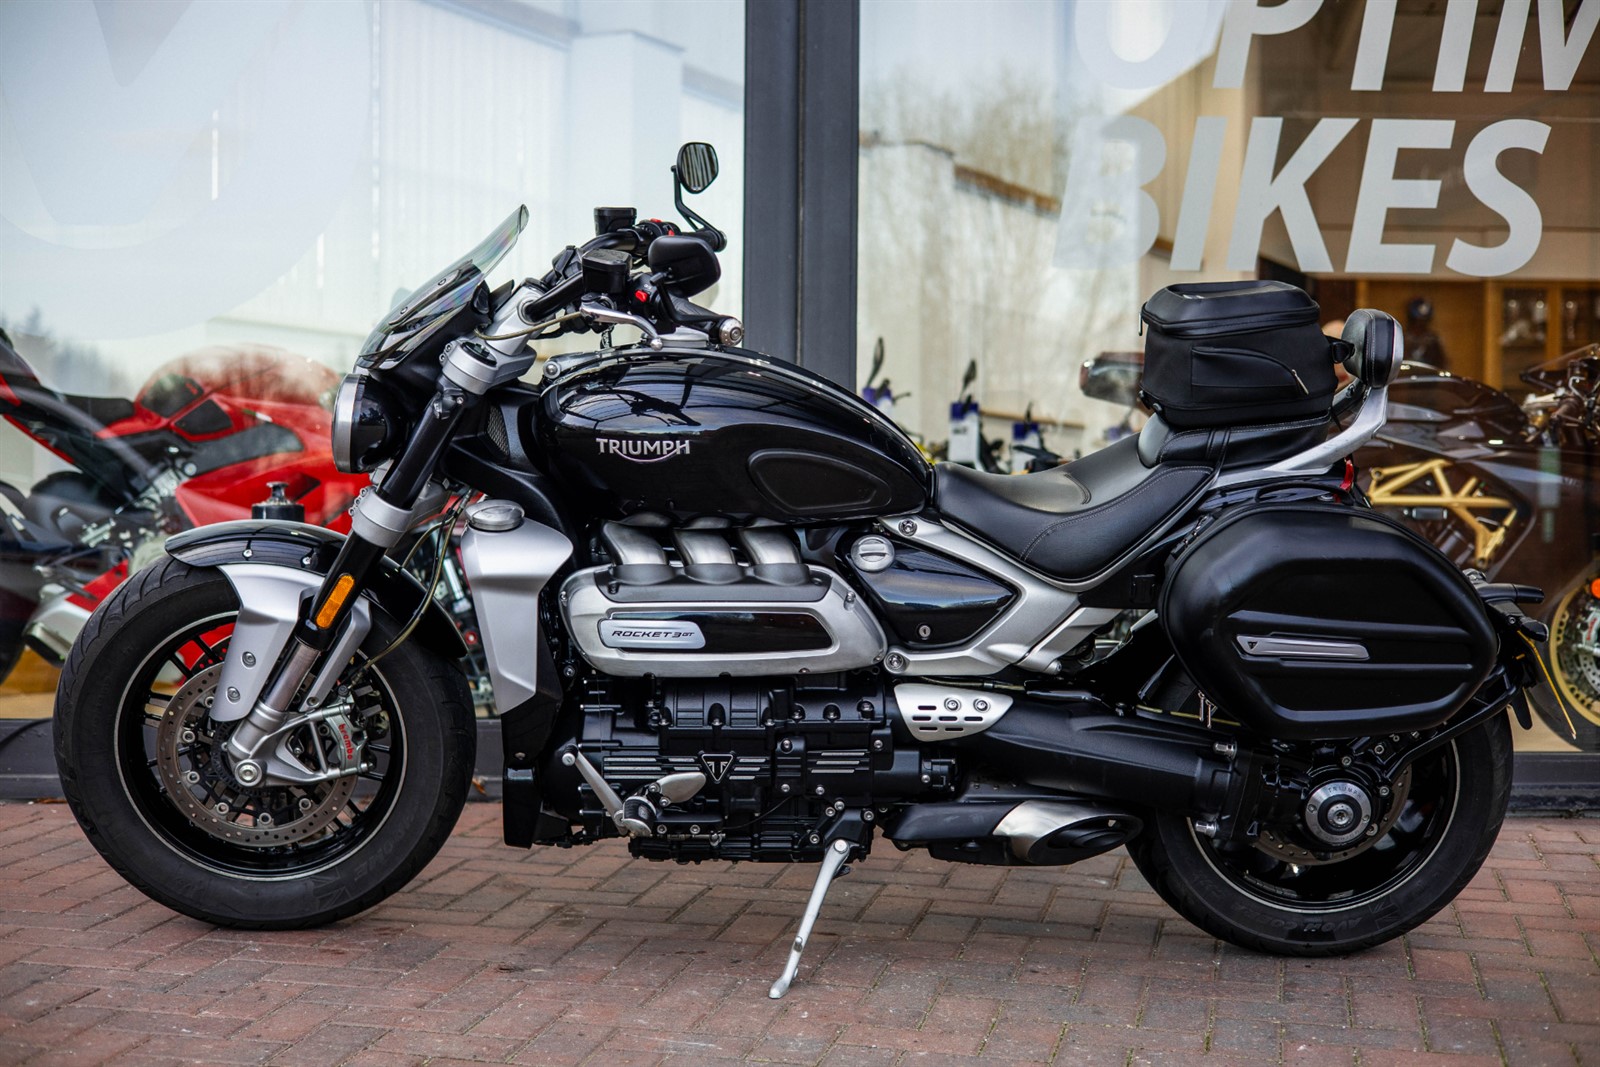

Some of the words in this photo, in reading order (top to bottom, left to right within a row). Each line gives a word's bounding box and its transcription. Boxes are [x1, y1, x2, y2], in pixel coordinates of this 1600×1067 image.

[1052, 117, 1552, 277] BIKES
[595, 437, 691, 460] TRIUMPH
[338, 723, 354, 760] brembo
